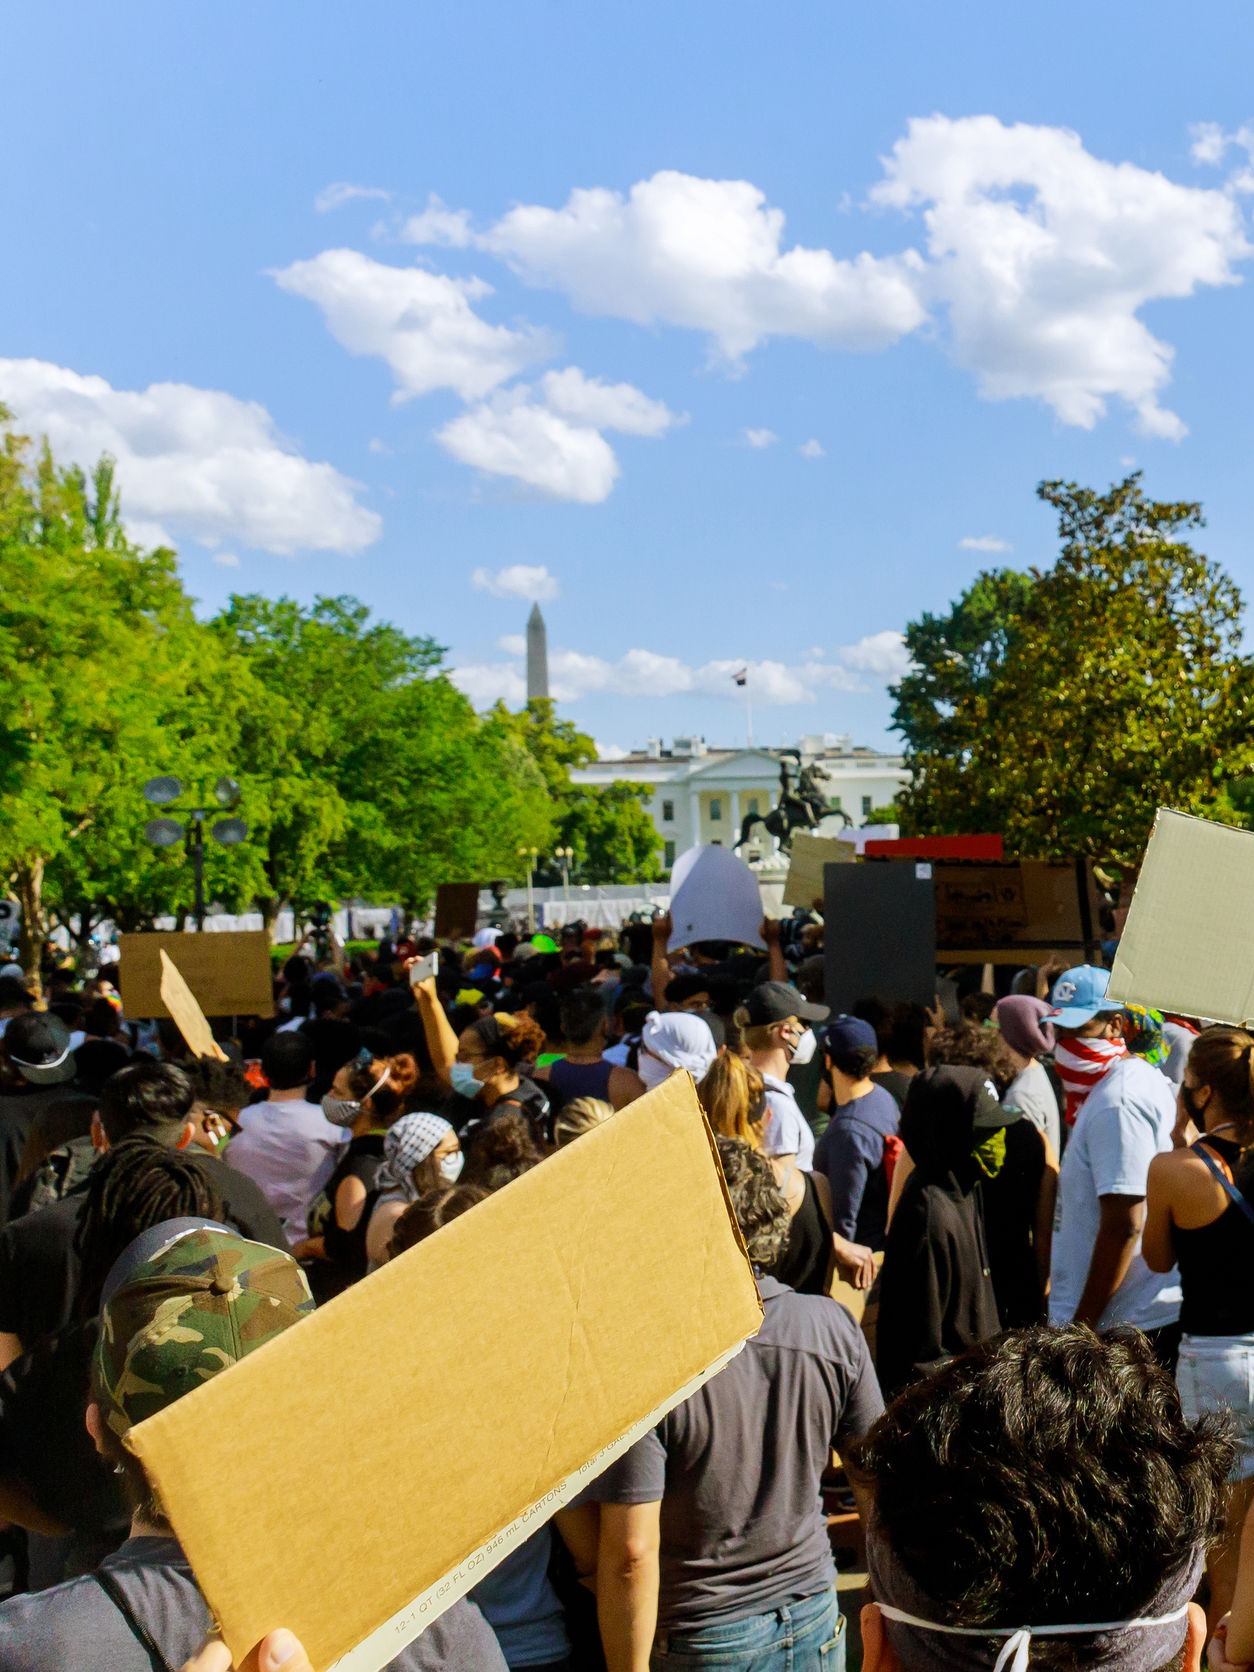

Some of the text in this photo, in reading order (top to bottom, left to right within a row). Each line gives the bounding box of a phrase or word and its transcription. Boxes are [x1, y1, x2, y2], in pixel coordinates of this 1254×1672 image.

[394, 1612, 417, 1633] 12-1
[418, 1596, 433, 1613] QT
[435, 1582, 451, 1600] (32
[453, 1571, 466, 1584] FL
[467, 1553, 485, 1571] OZ)
[486, 1536, 504, 1554] 946
[505, 1523, 520, 1538] mL
[521, 1483, 568, 1523] CARTONS
